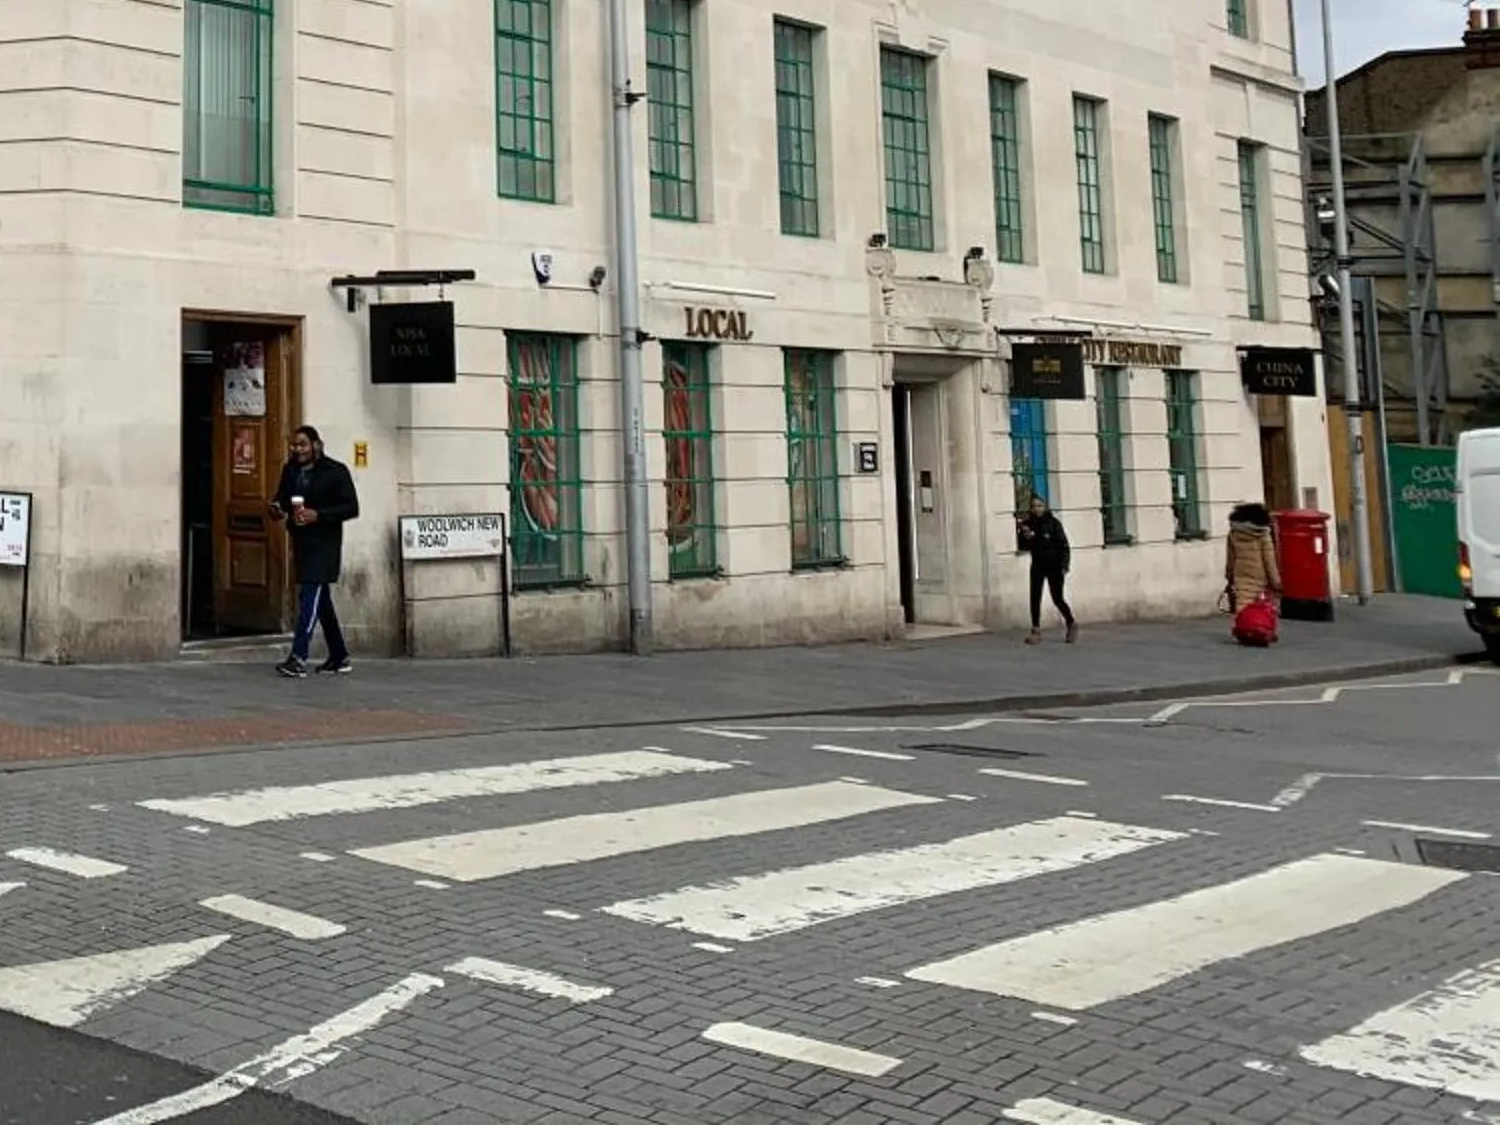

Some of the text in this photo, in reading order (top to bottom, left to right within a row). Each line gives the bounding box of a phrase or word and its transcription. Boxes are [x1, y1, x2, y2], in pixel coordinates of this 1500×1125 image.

[684, 306, 754, 340] LOCAL
[1108, 340, 1182, 365] RESTAURANT
[1256, 362, 1304, 374] CHINA
[1263, 376, 1299, 387] CITY
[417, 516, 499, 532] WOOLWICH NEW
[418, 534, 449, 548] ROAD
